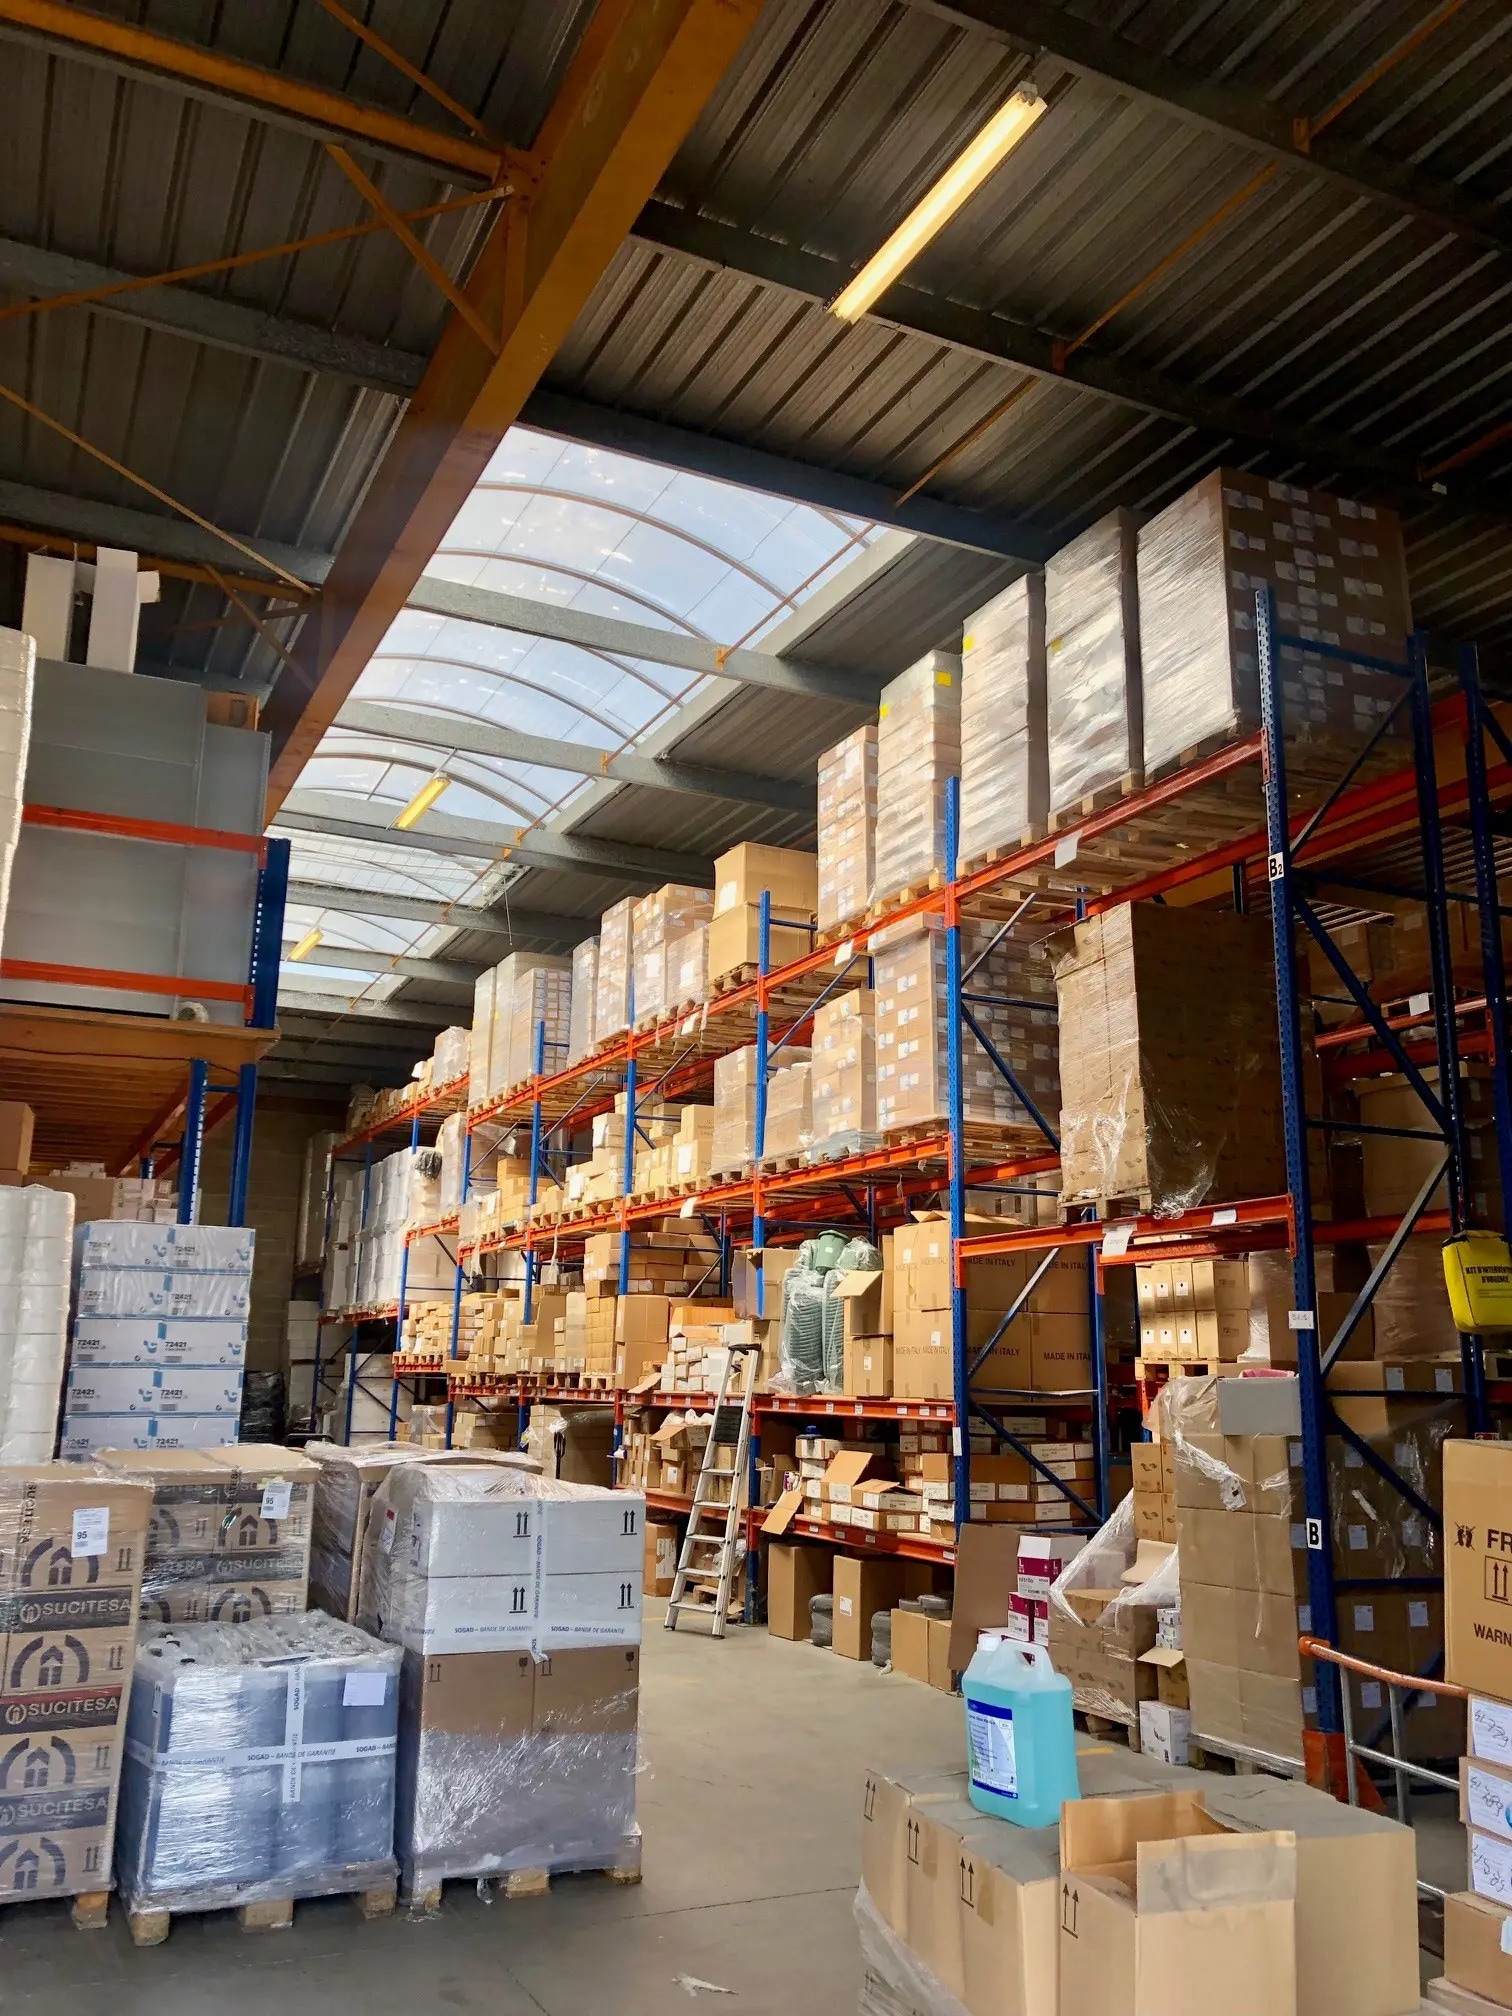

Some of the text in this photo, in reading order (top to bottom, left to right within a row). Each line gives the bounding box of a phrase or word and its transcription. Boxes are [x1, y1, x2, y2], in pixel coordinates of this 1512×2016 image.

[967, 1257, 983, 1265] ADE
[994, 1258, 1016, 1267] ITALY
[1037, 1261, 1059, 1269] MDE
[1060, 1261, 1069, 1269] IN
[1000, 1347, 1020, 1357] ITALY
[1043, 1352, 1065, 1360] MADE
[265, 1497, 274, 1505] 95
[20, 1483, 37, 1544] SUCITESA
[76, 1531, 88, 1540] 95
[1309, 1522, 1319, 1545] B
[1487, 1528, 1512, 1553] FR
[42, 1598, 132, 1615] SUCITESA
[1473, 1622, 1512, 1648] WARN
[28, 1697, 119, 1717] SUCITESA
[247, 1753, 270, 1762] SOGAD
[275, 1751, 296, 1760] BANDE
[306, 1748, 337, 1758] GARANTIE
[18, 1796, 108, 1818] SUCITESA
